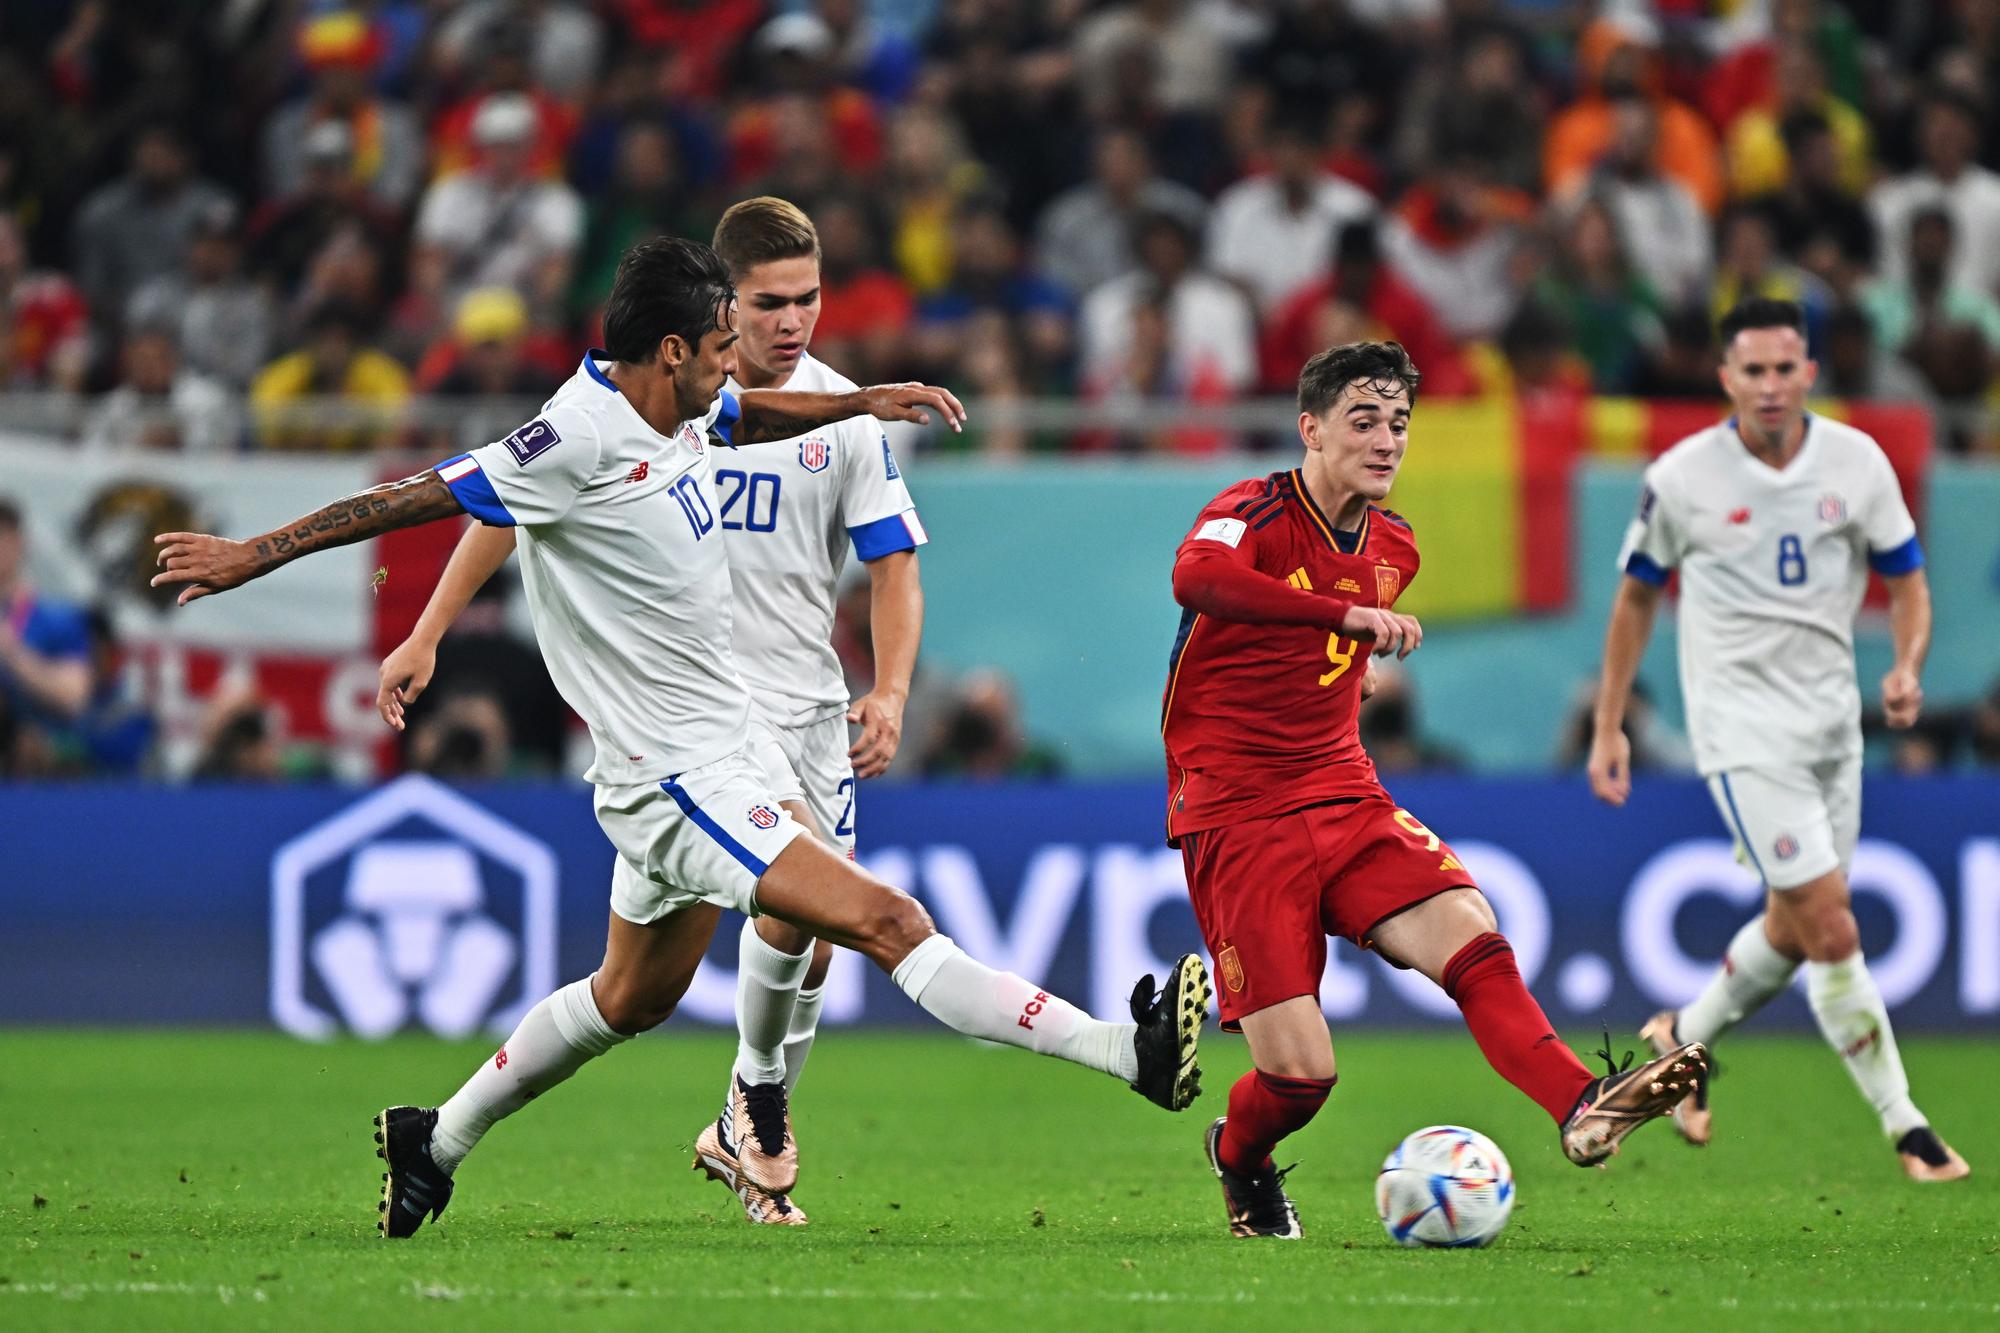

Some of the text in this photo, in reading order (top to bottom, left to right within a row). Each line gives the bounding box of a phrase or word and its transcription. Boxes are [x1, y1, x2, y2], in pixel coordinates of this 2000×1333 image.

[805, 443, 824, 468] CR
[667, 474, 713, 541] 10
[715, 469, 781, 533] 20
[1777, 534, 1807, 587] 8
[1319, 631, 1358, 687] 9
[752, 809, 774, 826] CR
[1393, 809, 1440, 852] 9
[1018, 991, 1050, 1031] FCR
